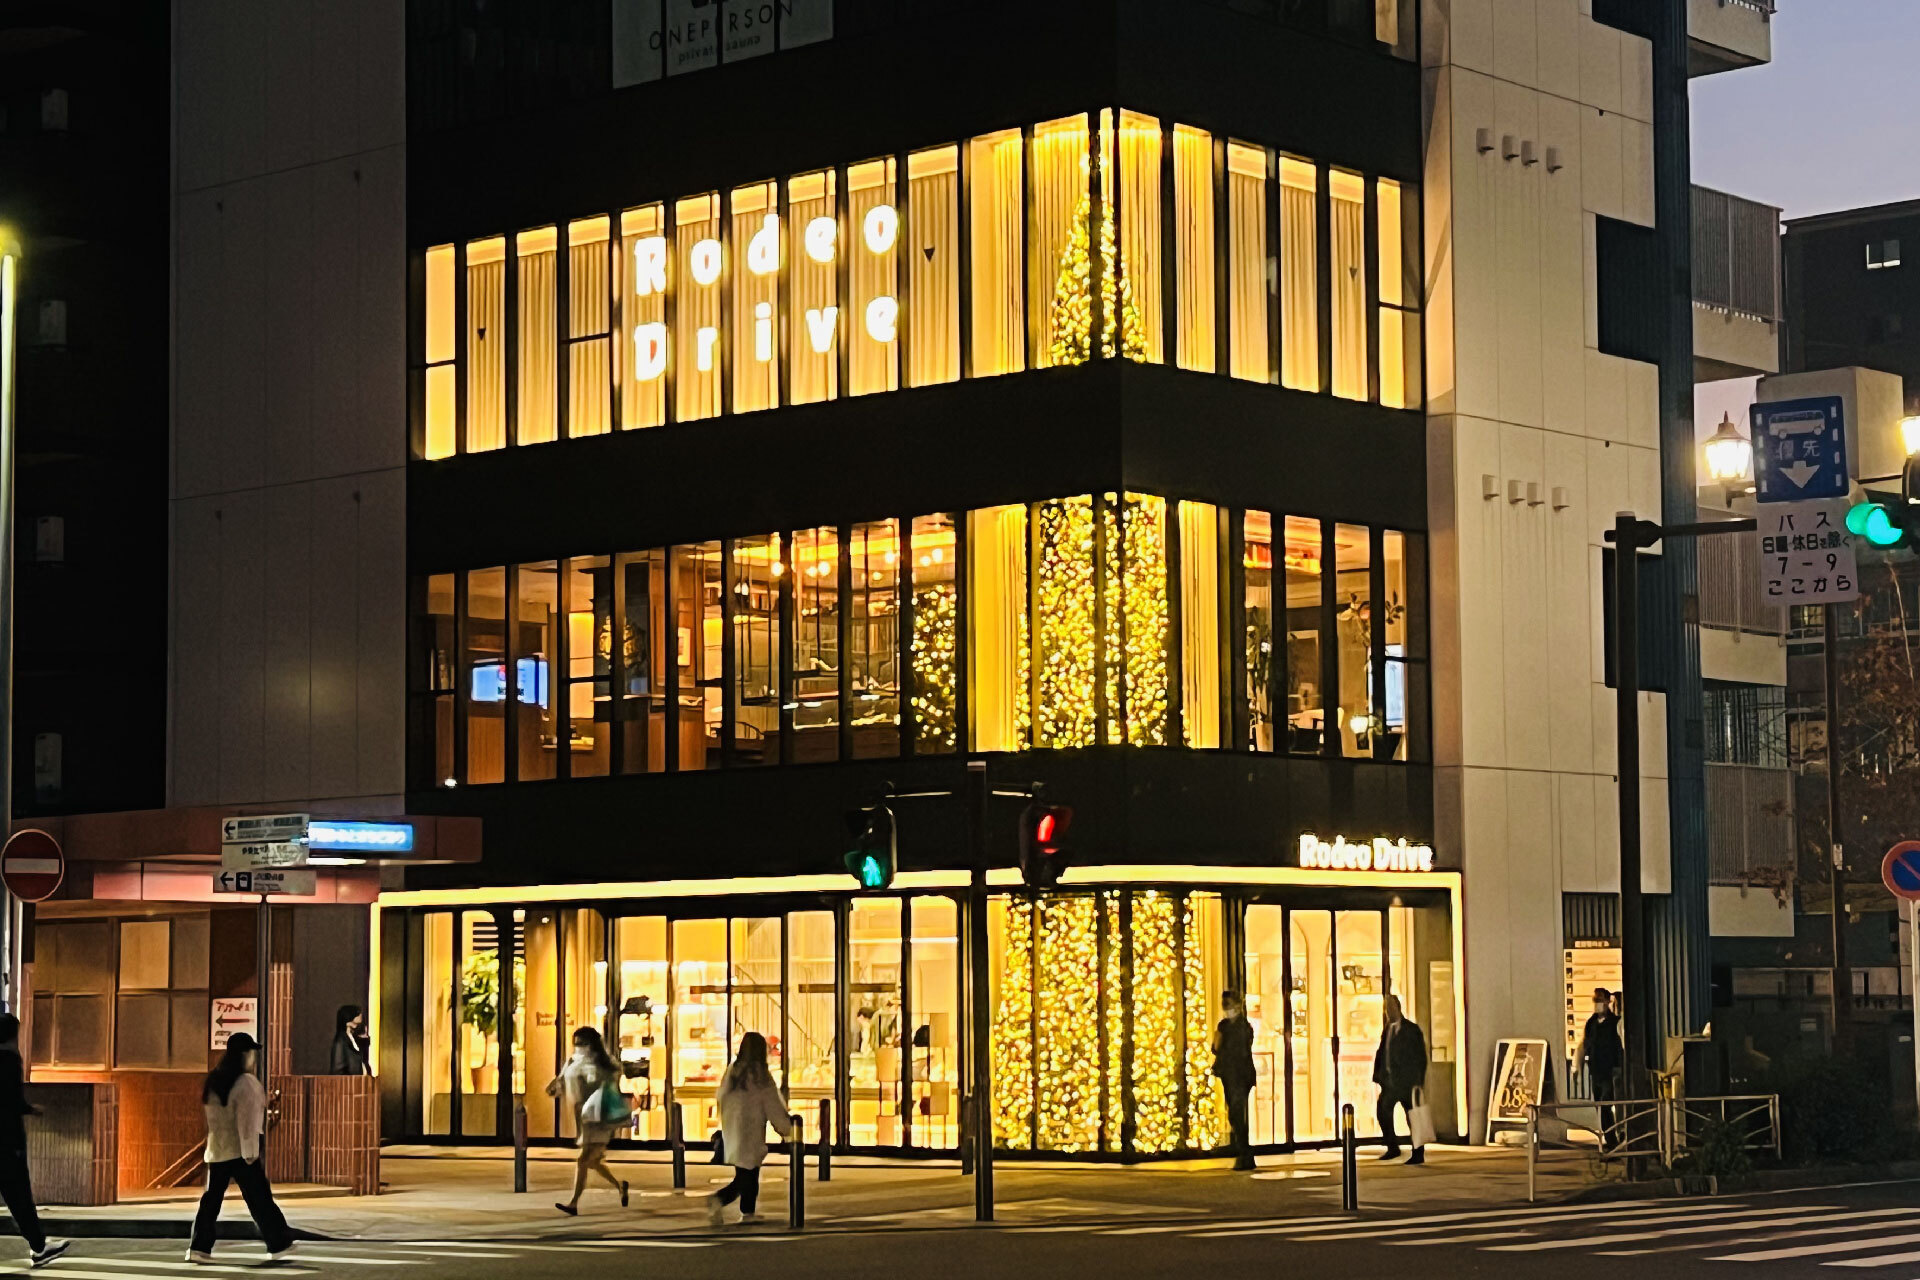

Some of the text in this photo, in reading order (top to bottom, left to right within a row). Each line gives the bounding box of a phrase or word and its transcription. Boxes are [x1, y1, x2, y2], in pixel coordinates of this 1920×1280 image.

[649, 0, 793, 51] ONEPRSON
[678, 46, 717, 65] privat
[634, 204, 899, 296] Rodeo
[634, 295, 899, 382] Drive
[1779, 511, 1831, 532] バス
[1768, 574, 1851, 596] ここから
[1299, 834, 1434, 872] Rodeo Drive
